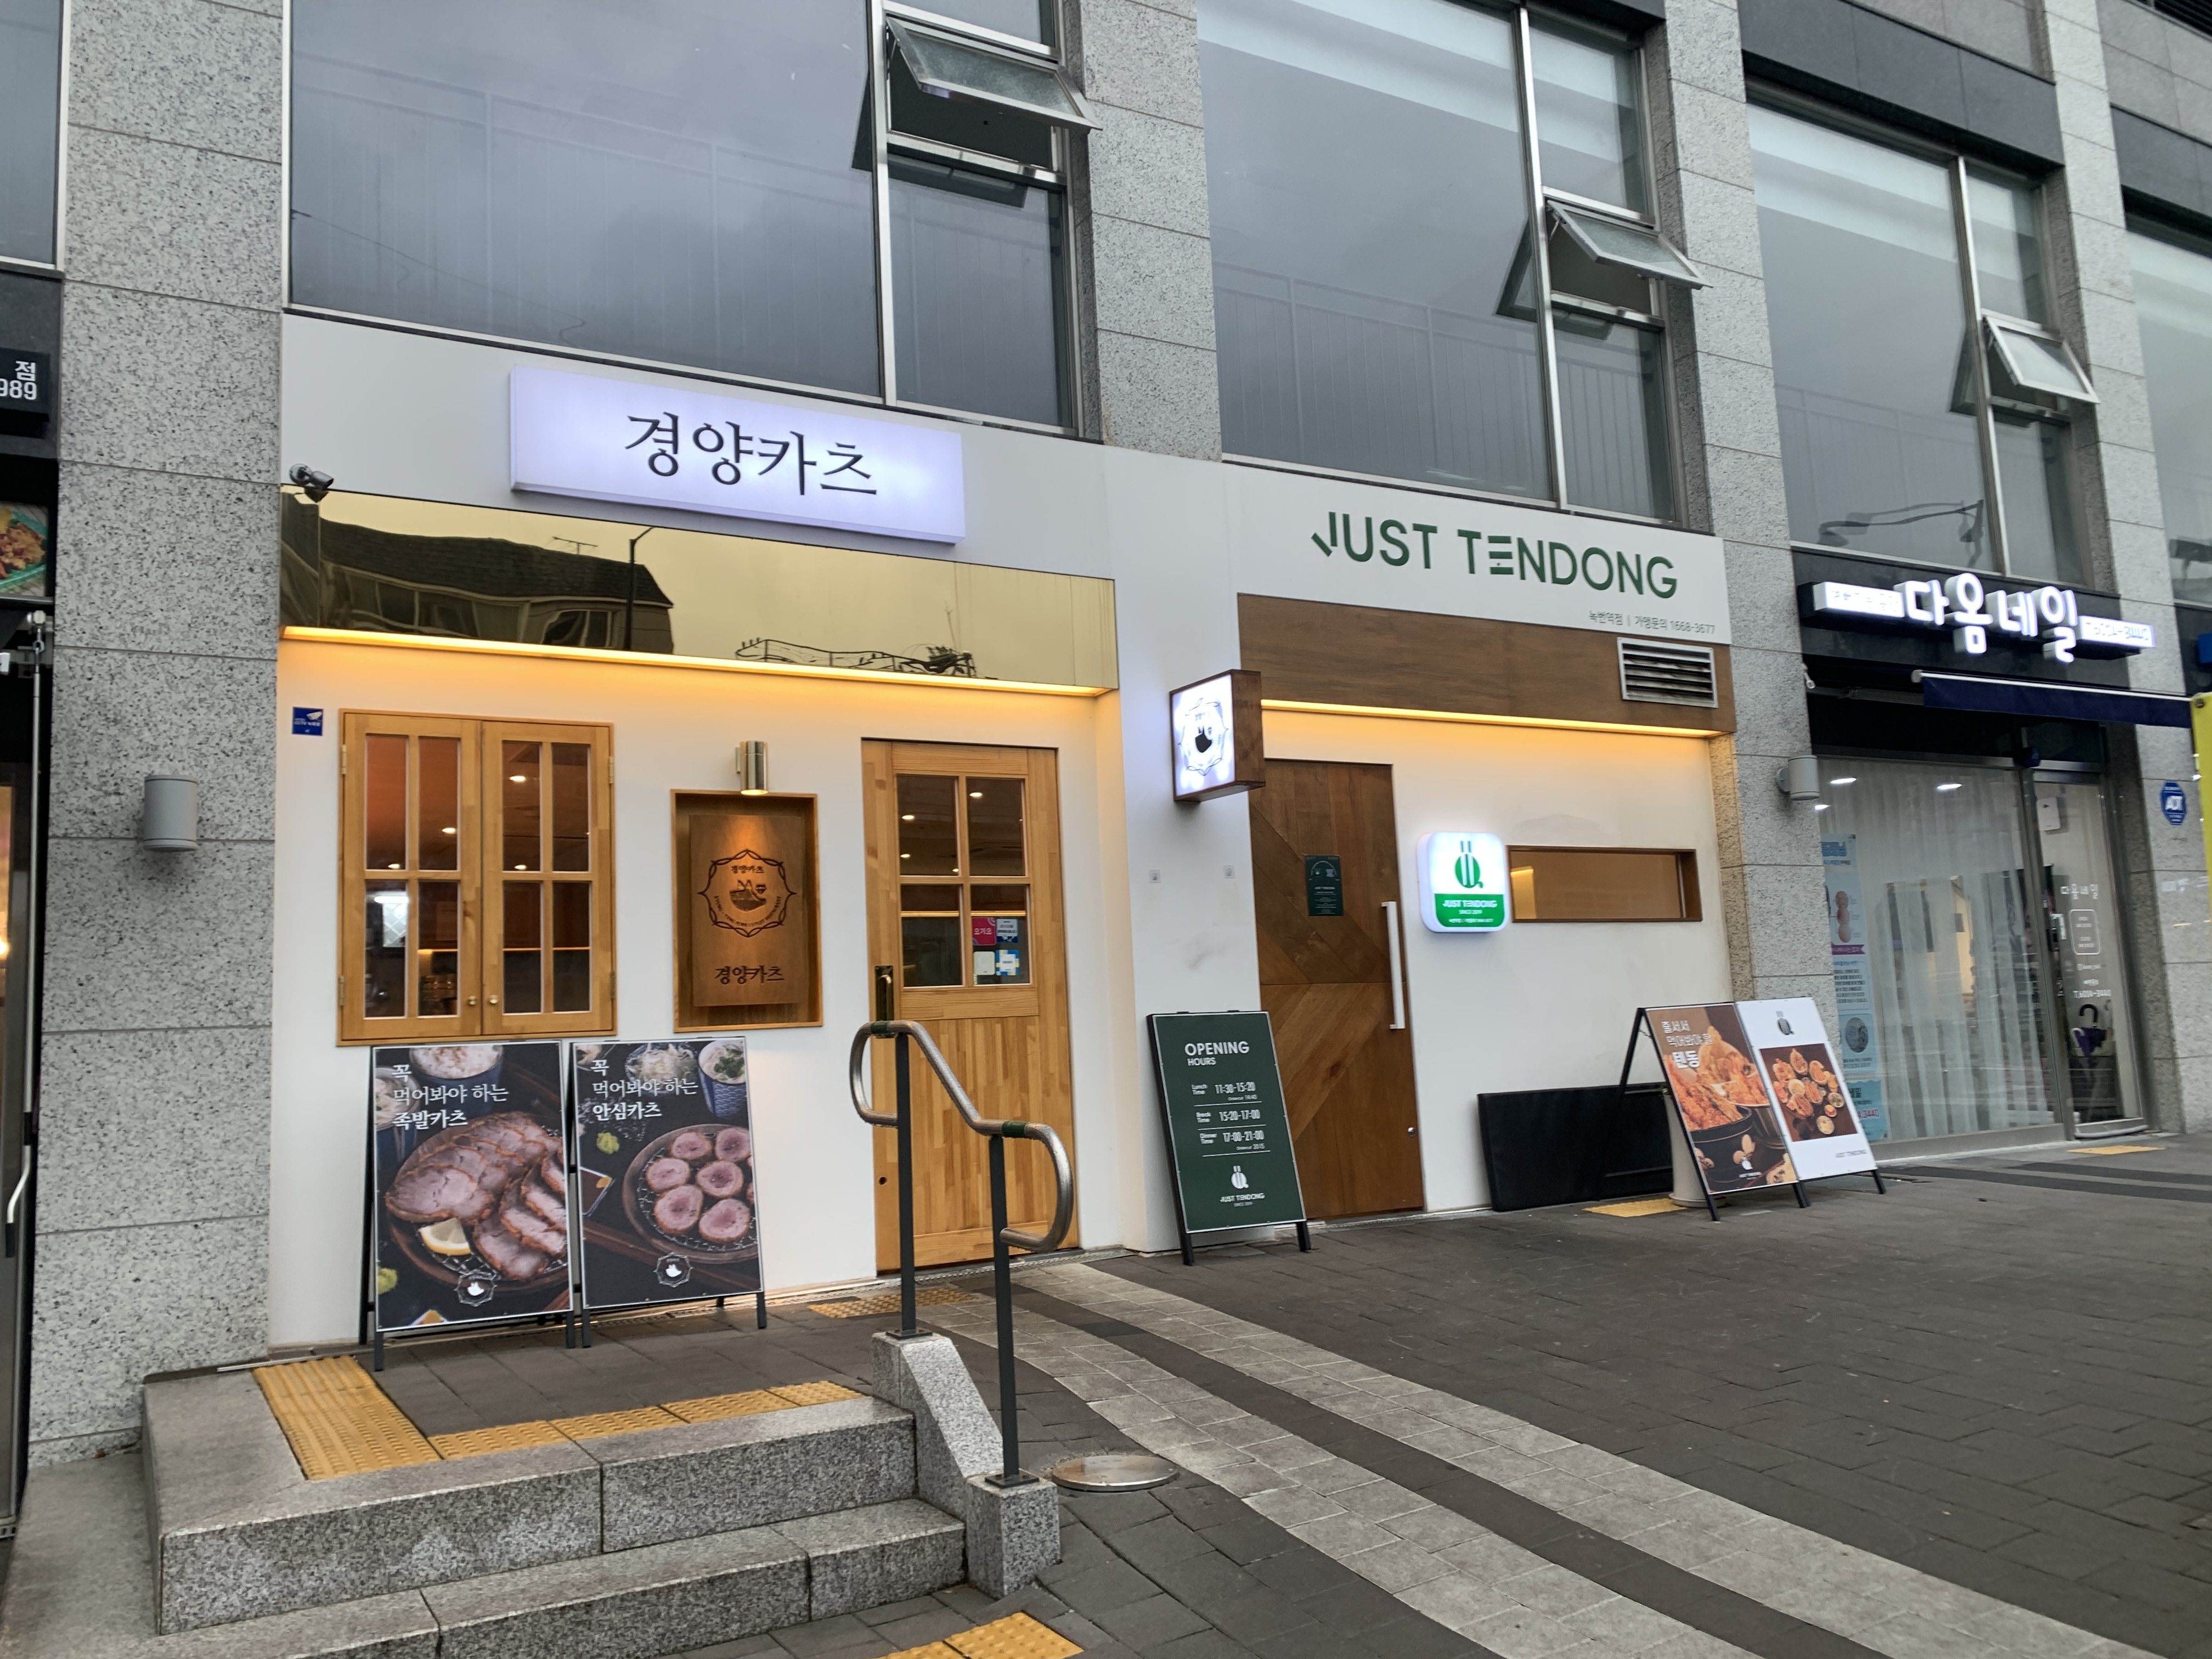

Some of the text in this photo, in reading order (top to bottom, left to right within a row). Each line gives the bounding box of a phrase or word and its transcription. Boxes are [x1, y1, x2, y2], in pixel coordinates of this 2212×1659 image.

[15, 360, 36, 381] 점
[625, 411, 877, 495] 경양카츠
[1311, 511, 1677, 599] JUST TENDONG
[714, 965, 785, 985] 경양카츠
[1184, 1041, 1250, 1056] OPENING
[590, 1059, 610, 1076] 꼭
[1187, 1057, 1217, 1066] HOURS
[1672, 1050, 1700, 1069] 텐동
[392, 1064, 412, 1082] 꼭
[393, 1084, 510, 1106] 먹어봐야 하는
[592, 1077, 699, 1098] 먹어봐야 하는
[392, 1109, 469, 1131] 족발카츠
[592, 1101, 663, 1121] 안심카츠
[1235, 1193, 1266, 1201] TENDONG
